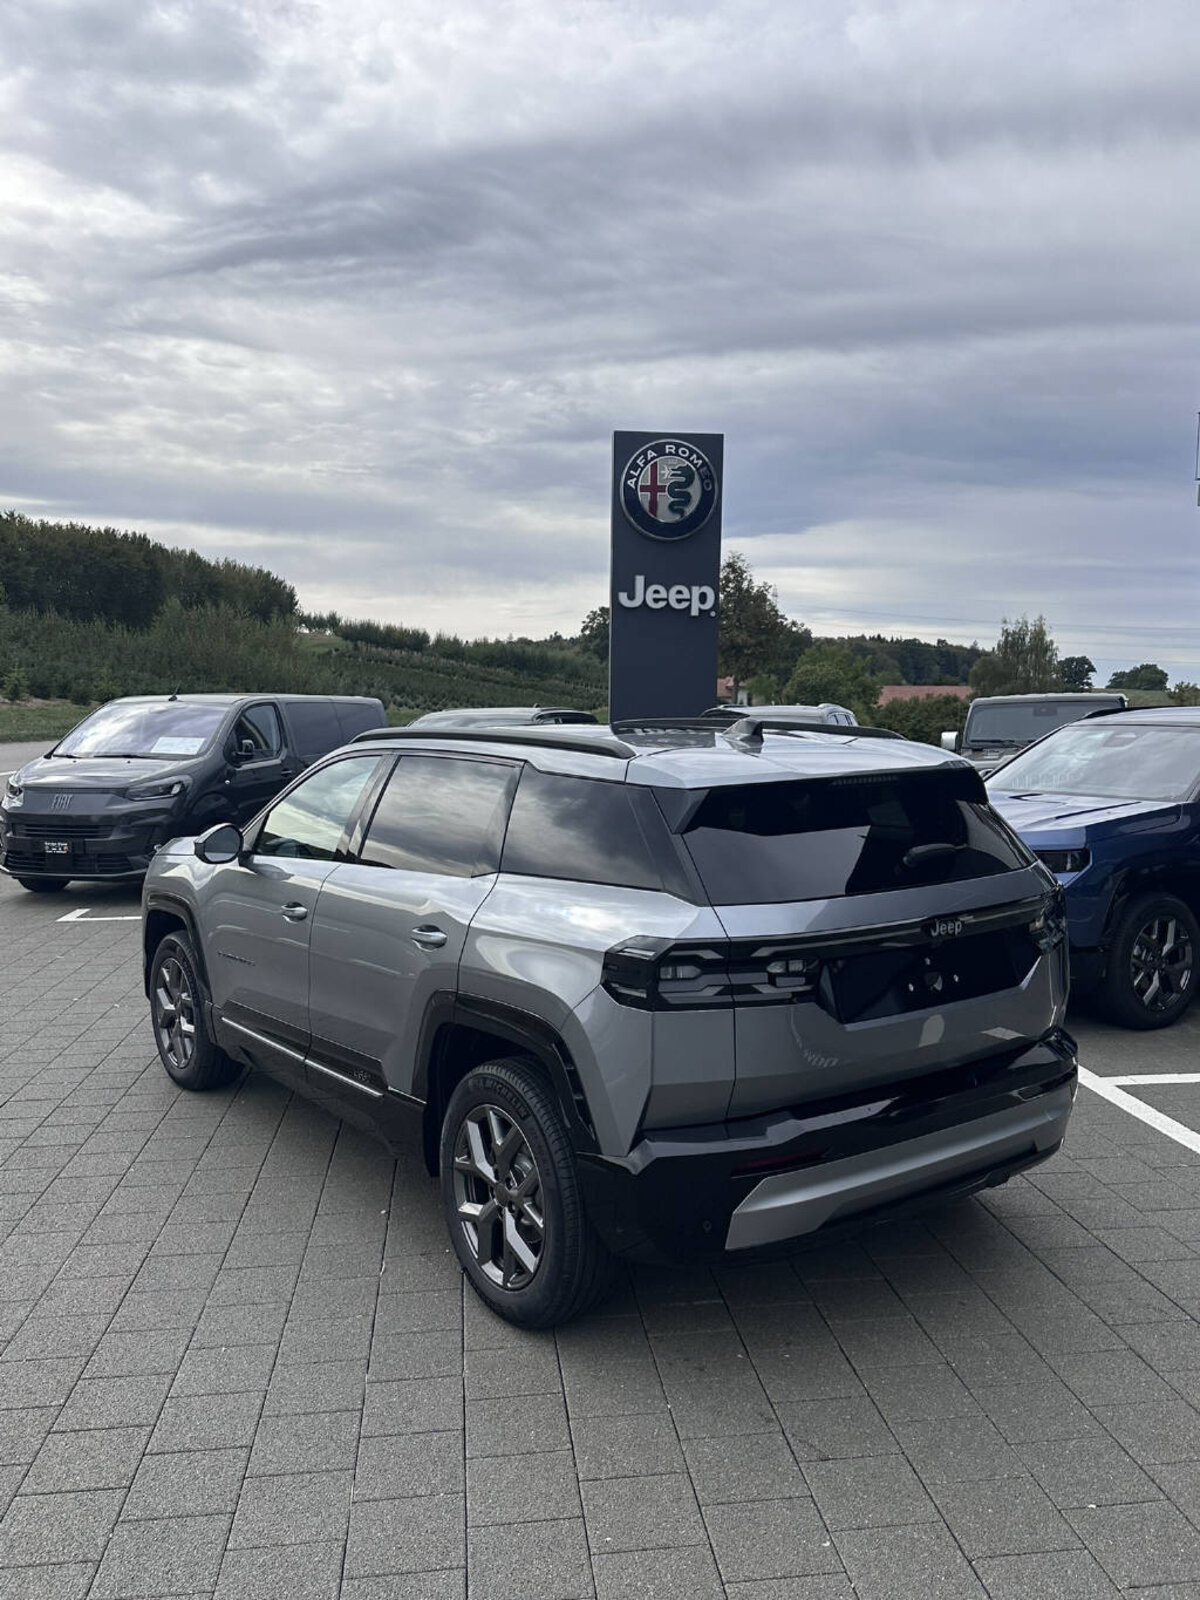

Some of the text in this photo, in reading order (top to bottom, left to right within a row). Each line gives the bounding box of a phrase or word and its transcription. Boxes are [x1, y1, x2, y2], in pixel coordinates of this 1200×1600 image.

[627, 444, 712, 491] ALFA ROMEO
[51, 793, 73, 809] FIAT
[930, 919, 962, 937] Jeep
